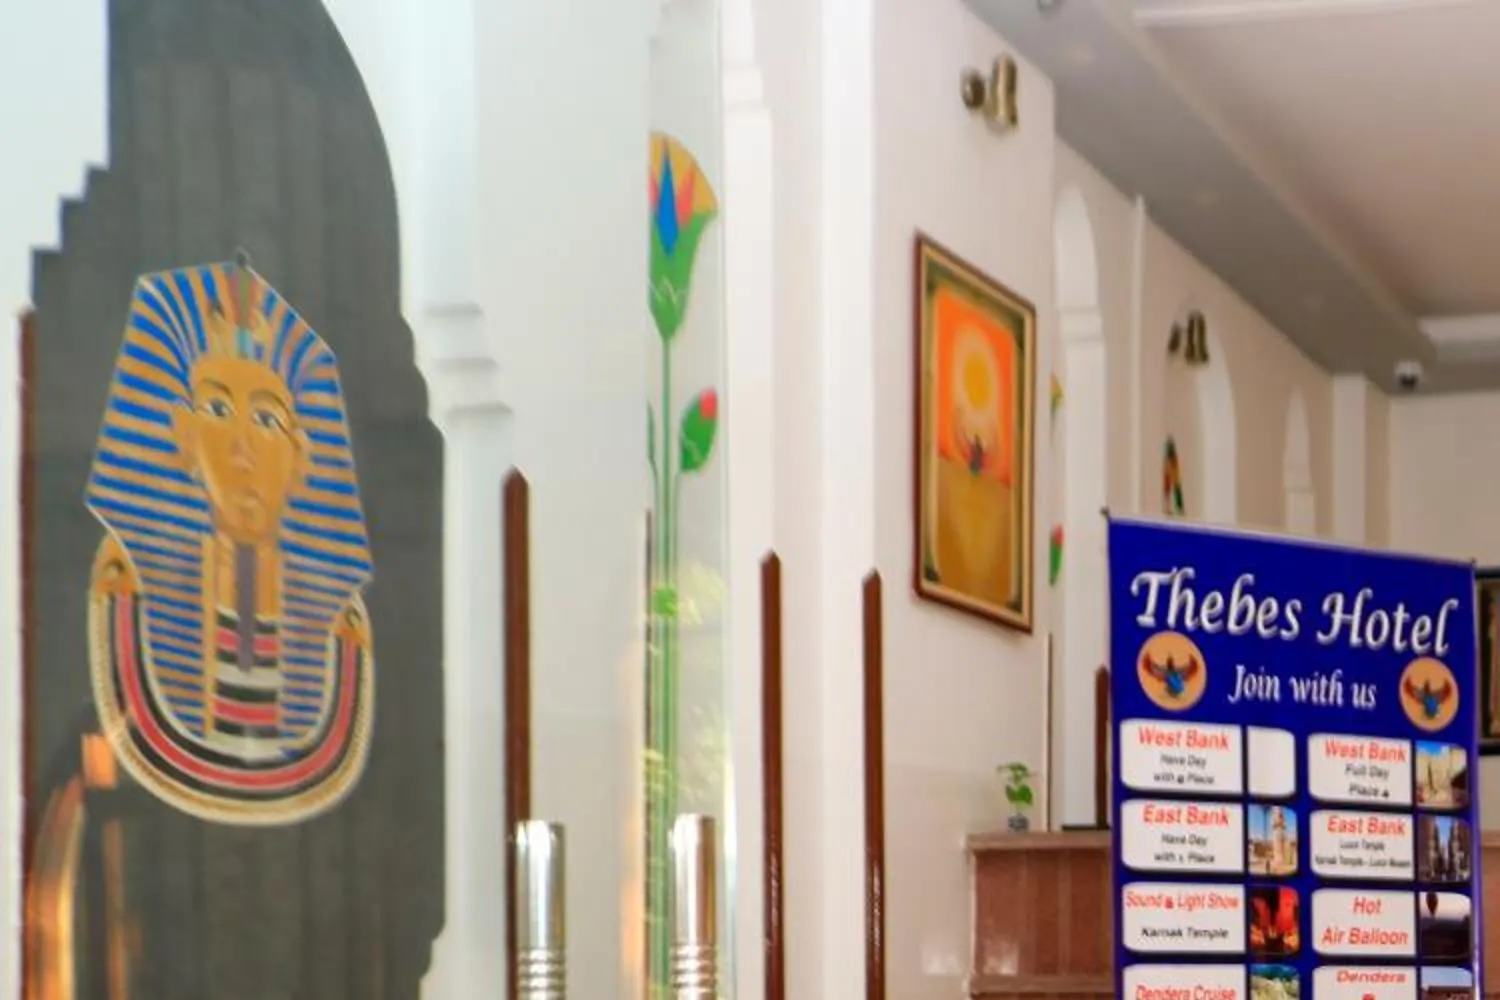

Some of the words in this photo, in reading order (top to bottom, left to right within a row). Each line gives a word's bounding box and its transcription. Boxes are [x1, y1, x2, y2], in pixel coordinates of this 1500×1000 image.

[1131, 567, 1302, 640] Thebes
[1316, 587, 1459, 656] Hotel
[1228, 664, 1281, 704] Join
[1289, 669, 1344, 707] with
[1351, 683, 1377, 709] us
[1138, 725, 1182, 746] West
[1186, 729, 1230, 751] Bank
[1324, 739, 1364, 759] West
[1368, 742, 1407, 762] Bank
[1369, 765, 1390, 780] Day
[1142, 804, 1182, 823] East
[1187, 806, 1230, 826] Bank
[1327, 815, 1364, 834] East
[1367, 817, 1407, 836] Bank
[1126, 891, 1163, 908] Sound
[1177, 893, 1205, 911] Light
[1353, 897, 1382, 914] Hot
[1141, 927, 1183, 938] Karnak
[1187, 927, 1229, 940] Temple
[1322, 927, 1344, 944] Air
[1348, 927, 1408, 945] Balloon
[1336, 970, 1407, 983] Dendera
